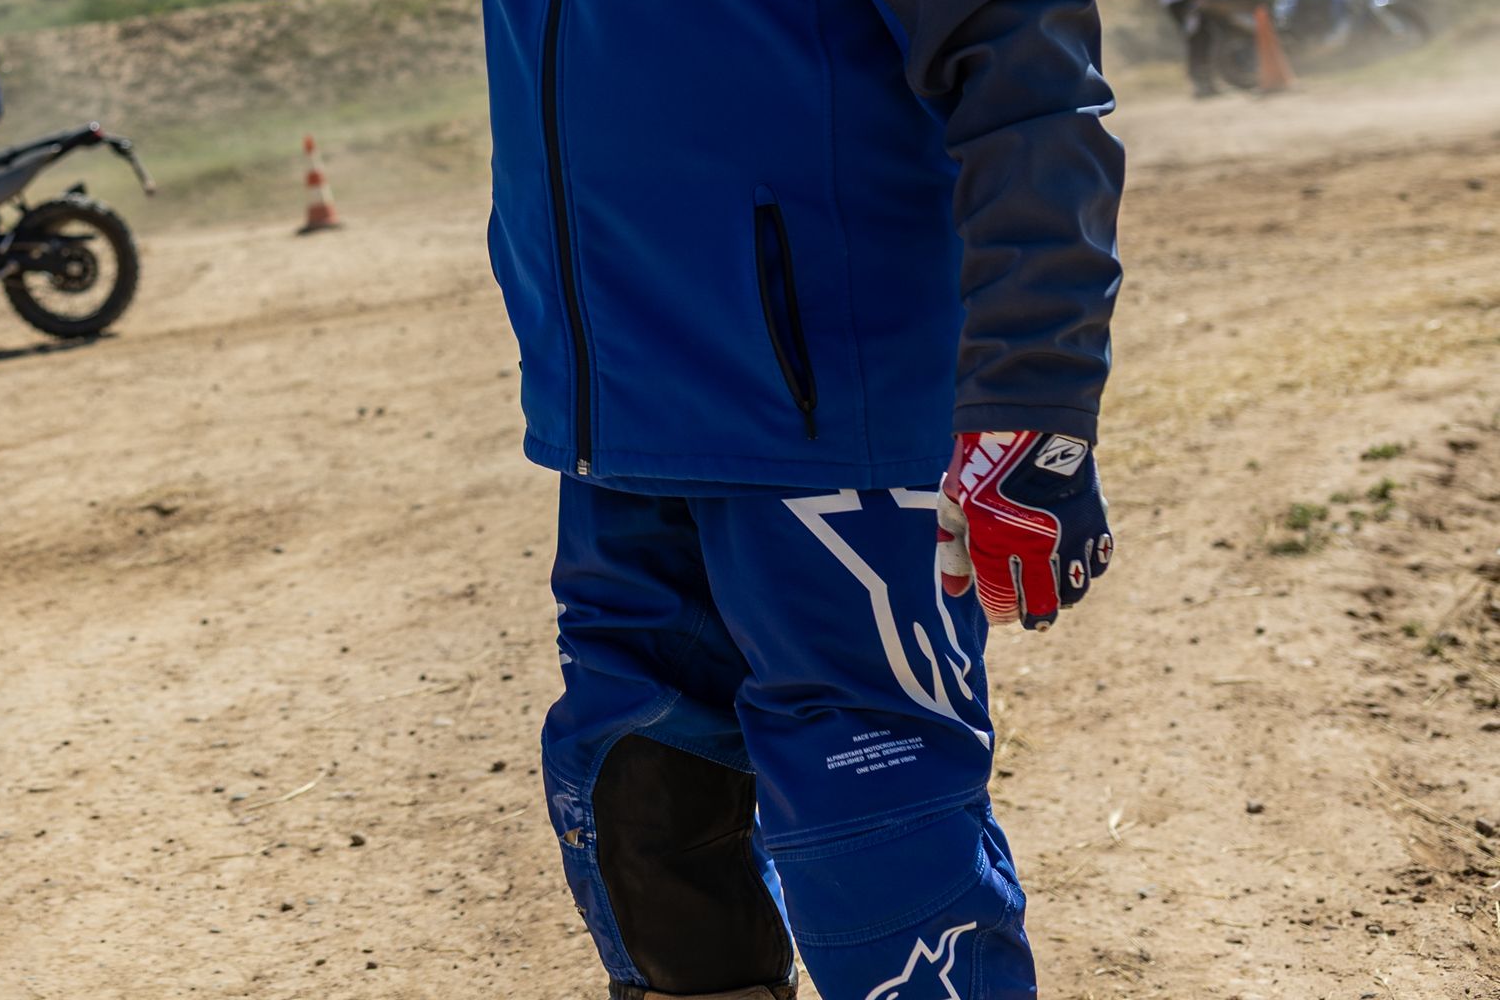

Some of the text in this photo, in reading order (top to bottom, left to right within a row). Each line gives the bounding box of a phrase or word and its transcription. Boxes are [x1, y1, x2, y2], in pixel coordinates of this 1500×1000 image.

[852, 733, 869, 742] RACE
[826, 749, 863, 762] ALPINESTARS
[827, 756, 865, 770] ESTABLISHED
[856, 766, 869, 774] ONE
[888, 758, 900, 766] ONE
